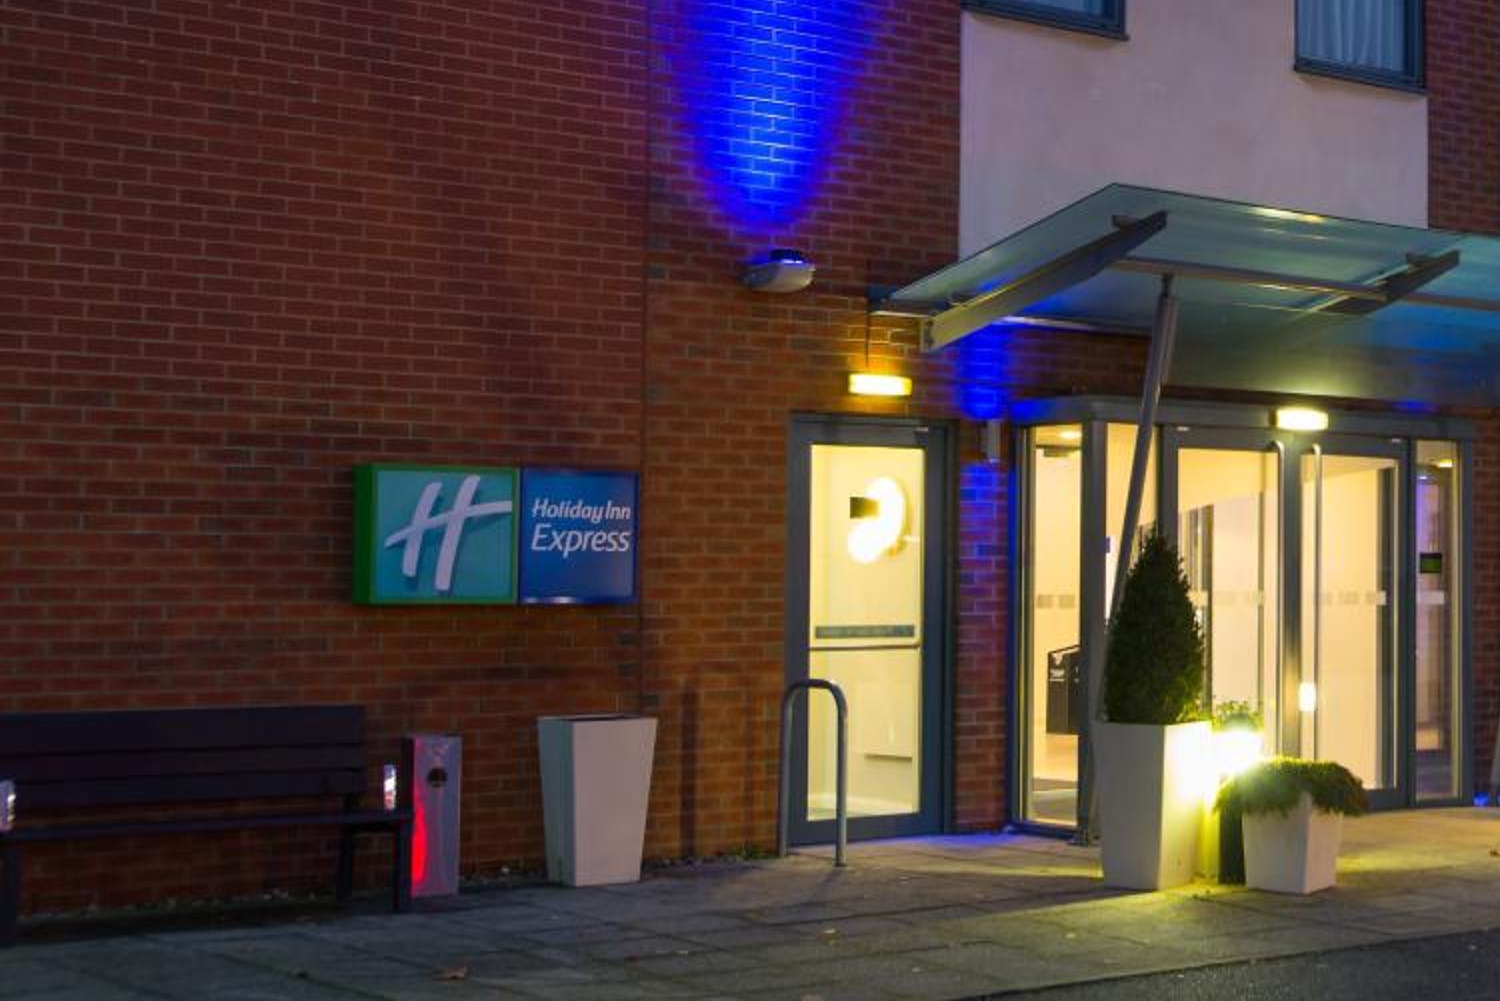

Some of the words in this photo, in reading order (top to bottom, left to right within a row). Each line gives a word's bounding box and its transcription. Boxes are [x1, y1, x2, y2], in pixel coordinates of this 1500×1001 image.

[532, 498, 604, 524] Holiday
[604, 500, 631, 519] Inn
[531, 523, 632, 558] Express
